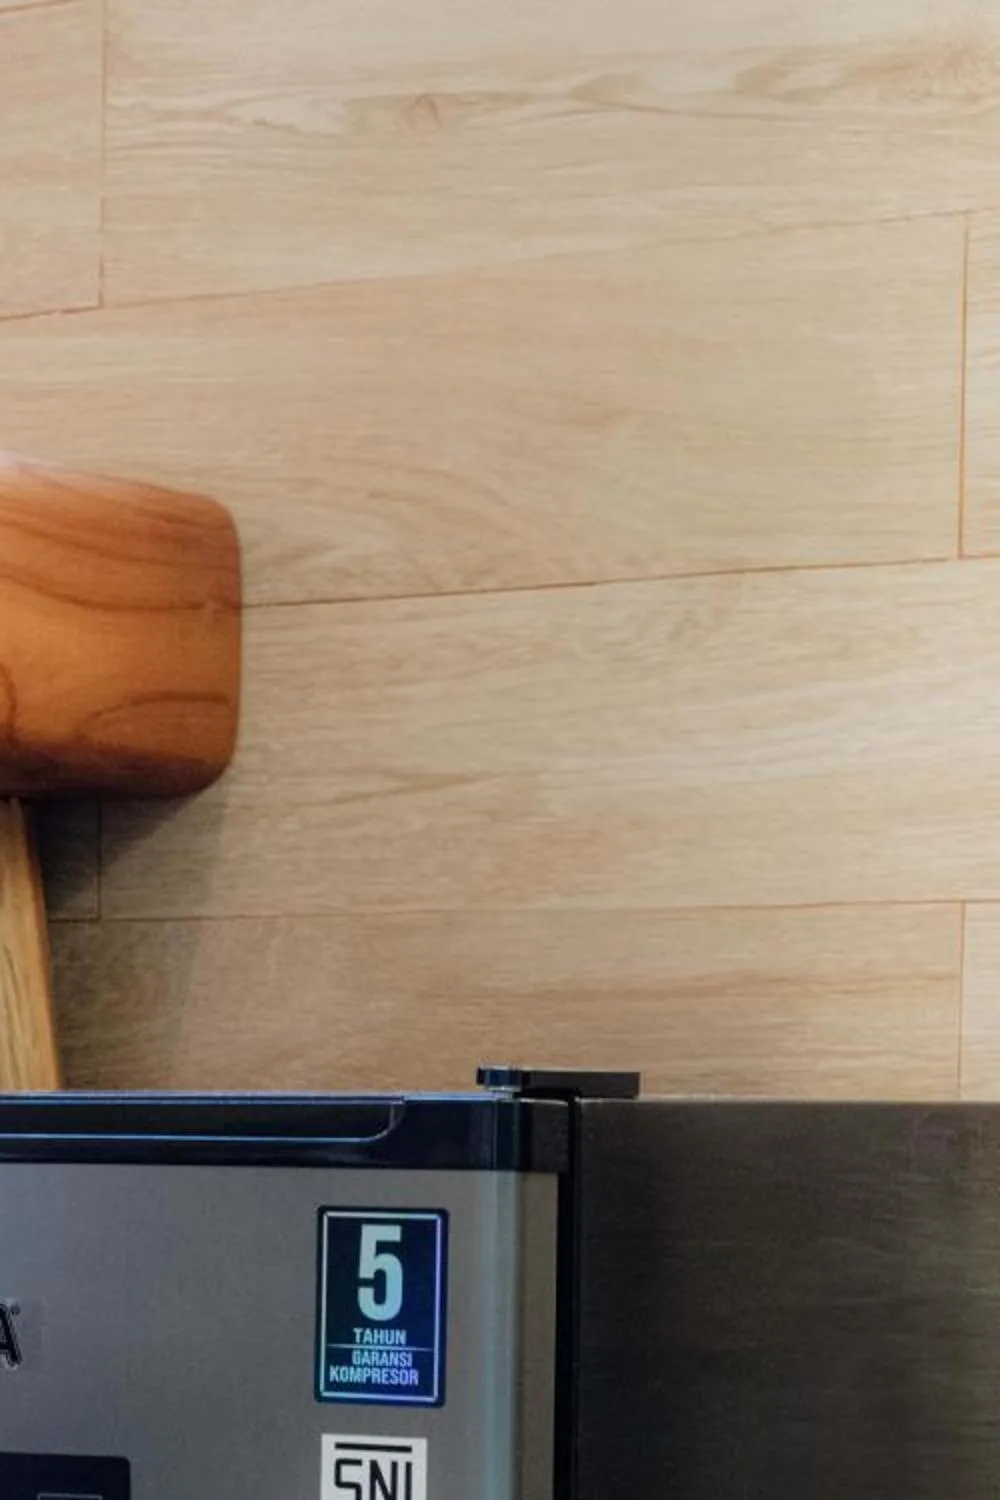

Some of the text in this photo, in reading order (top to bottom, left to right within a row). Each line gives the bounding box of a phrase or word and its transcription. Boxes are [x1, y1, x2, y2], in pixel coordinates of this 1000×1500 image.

[358, 1224, 403, 1321] 5
[353, 1328, 407, 1346] TAHUN
[352, 1351, 413, 1367] GARANSI
[329, 1366, 419, 1386] KOMPRESOR
